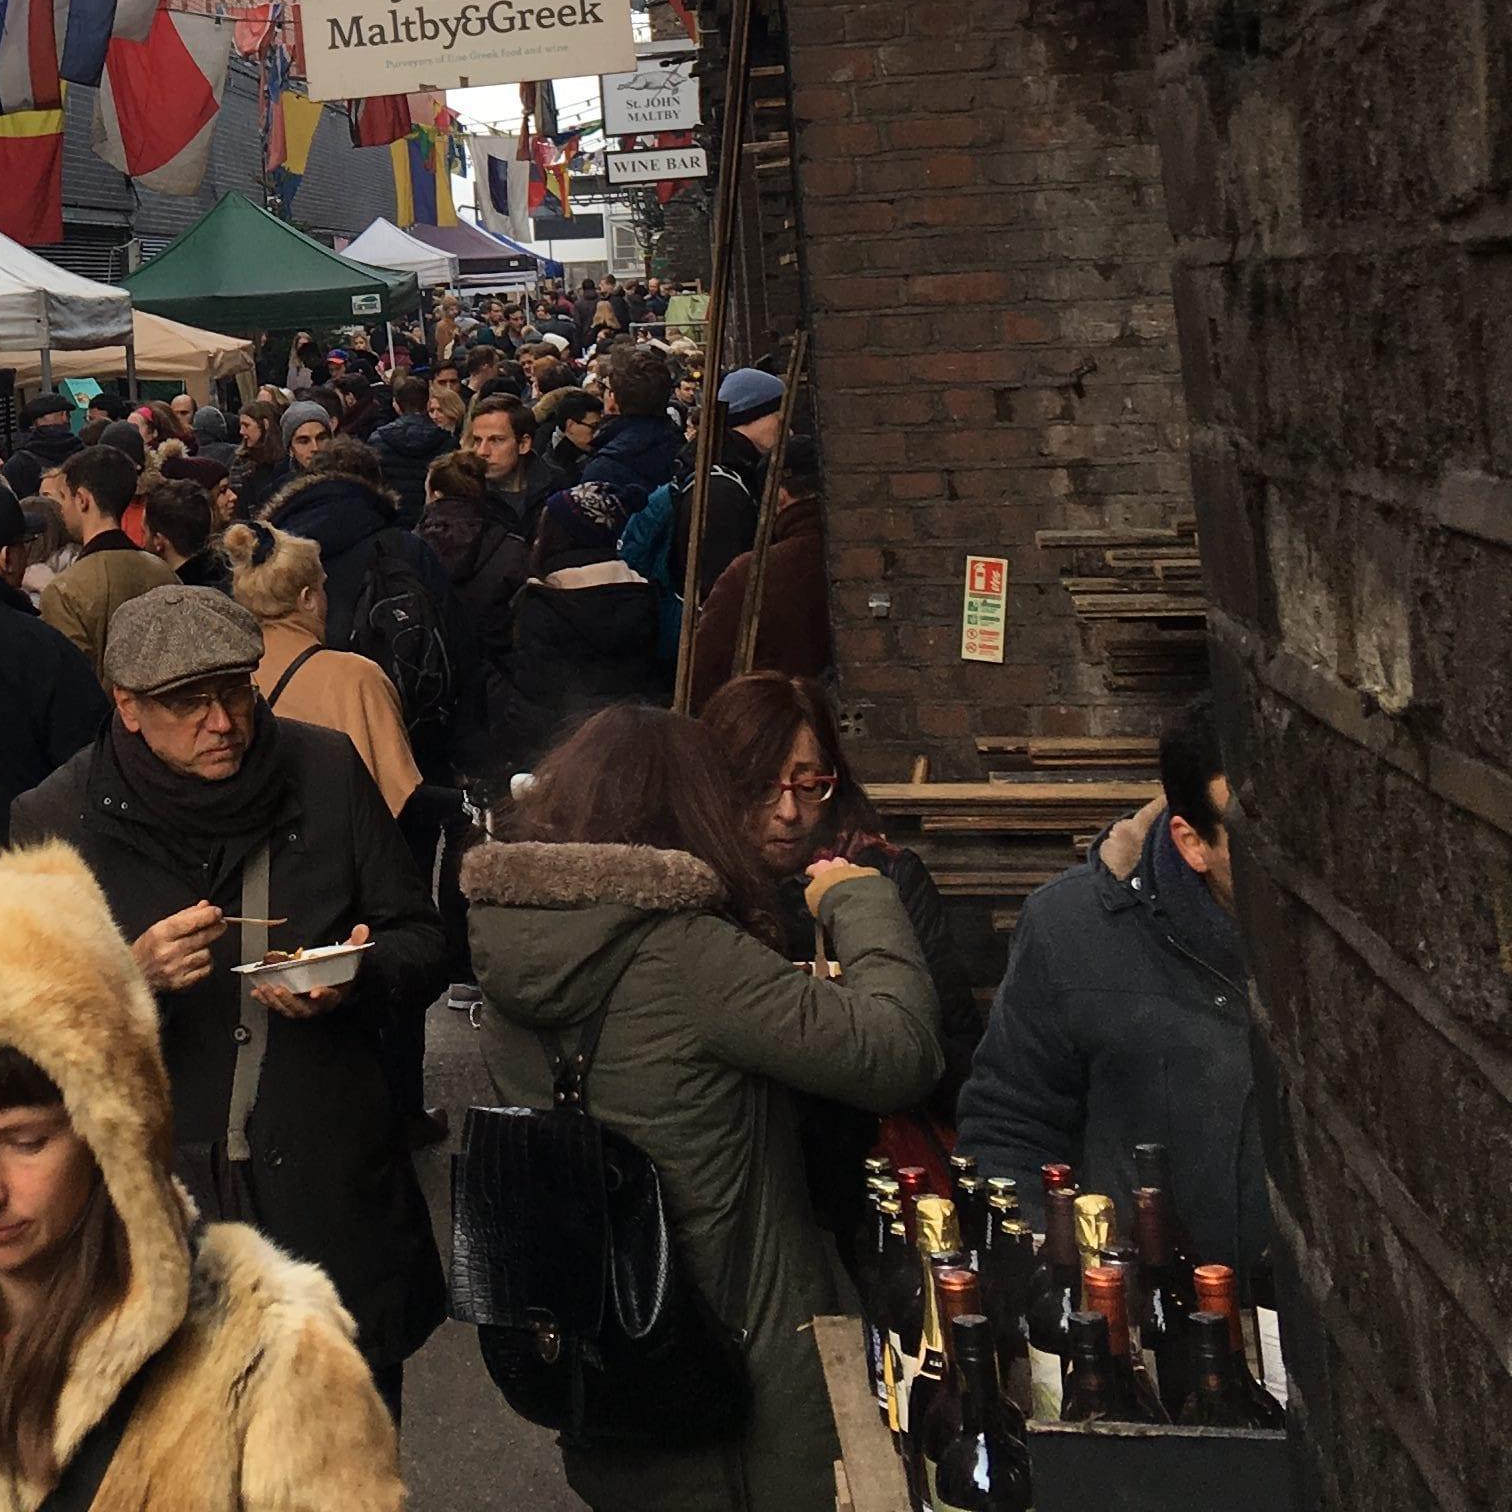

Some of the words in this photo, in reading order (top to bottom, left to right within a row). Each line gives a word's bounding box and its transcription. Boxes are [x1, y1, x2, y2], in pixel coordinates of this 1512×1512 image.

[643, 95, 680, 109] JOHN
[627, 109, 680, 122] MALTBY
[614, 158, 661, 173] WINE
[666, 155, 701, 170] BAR
